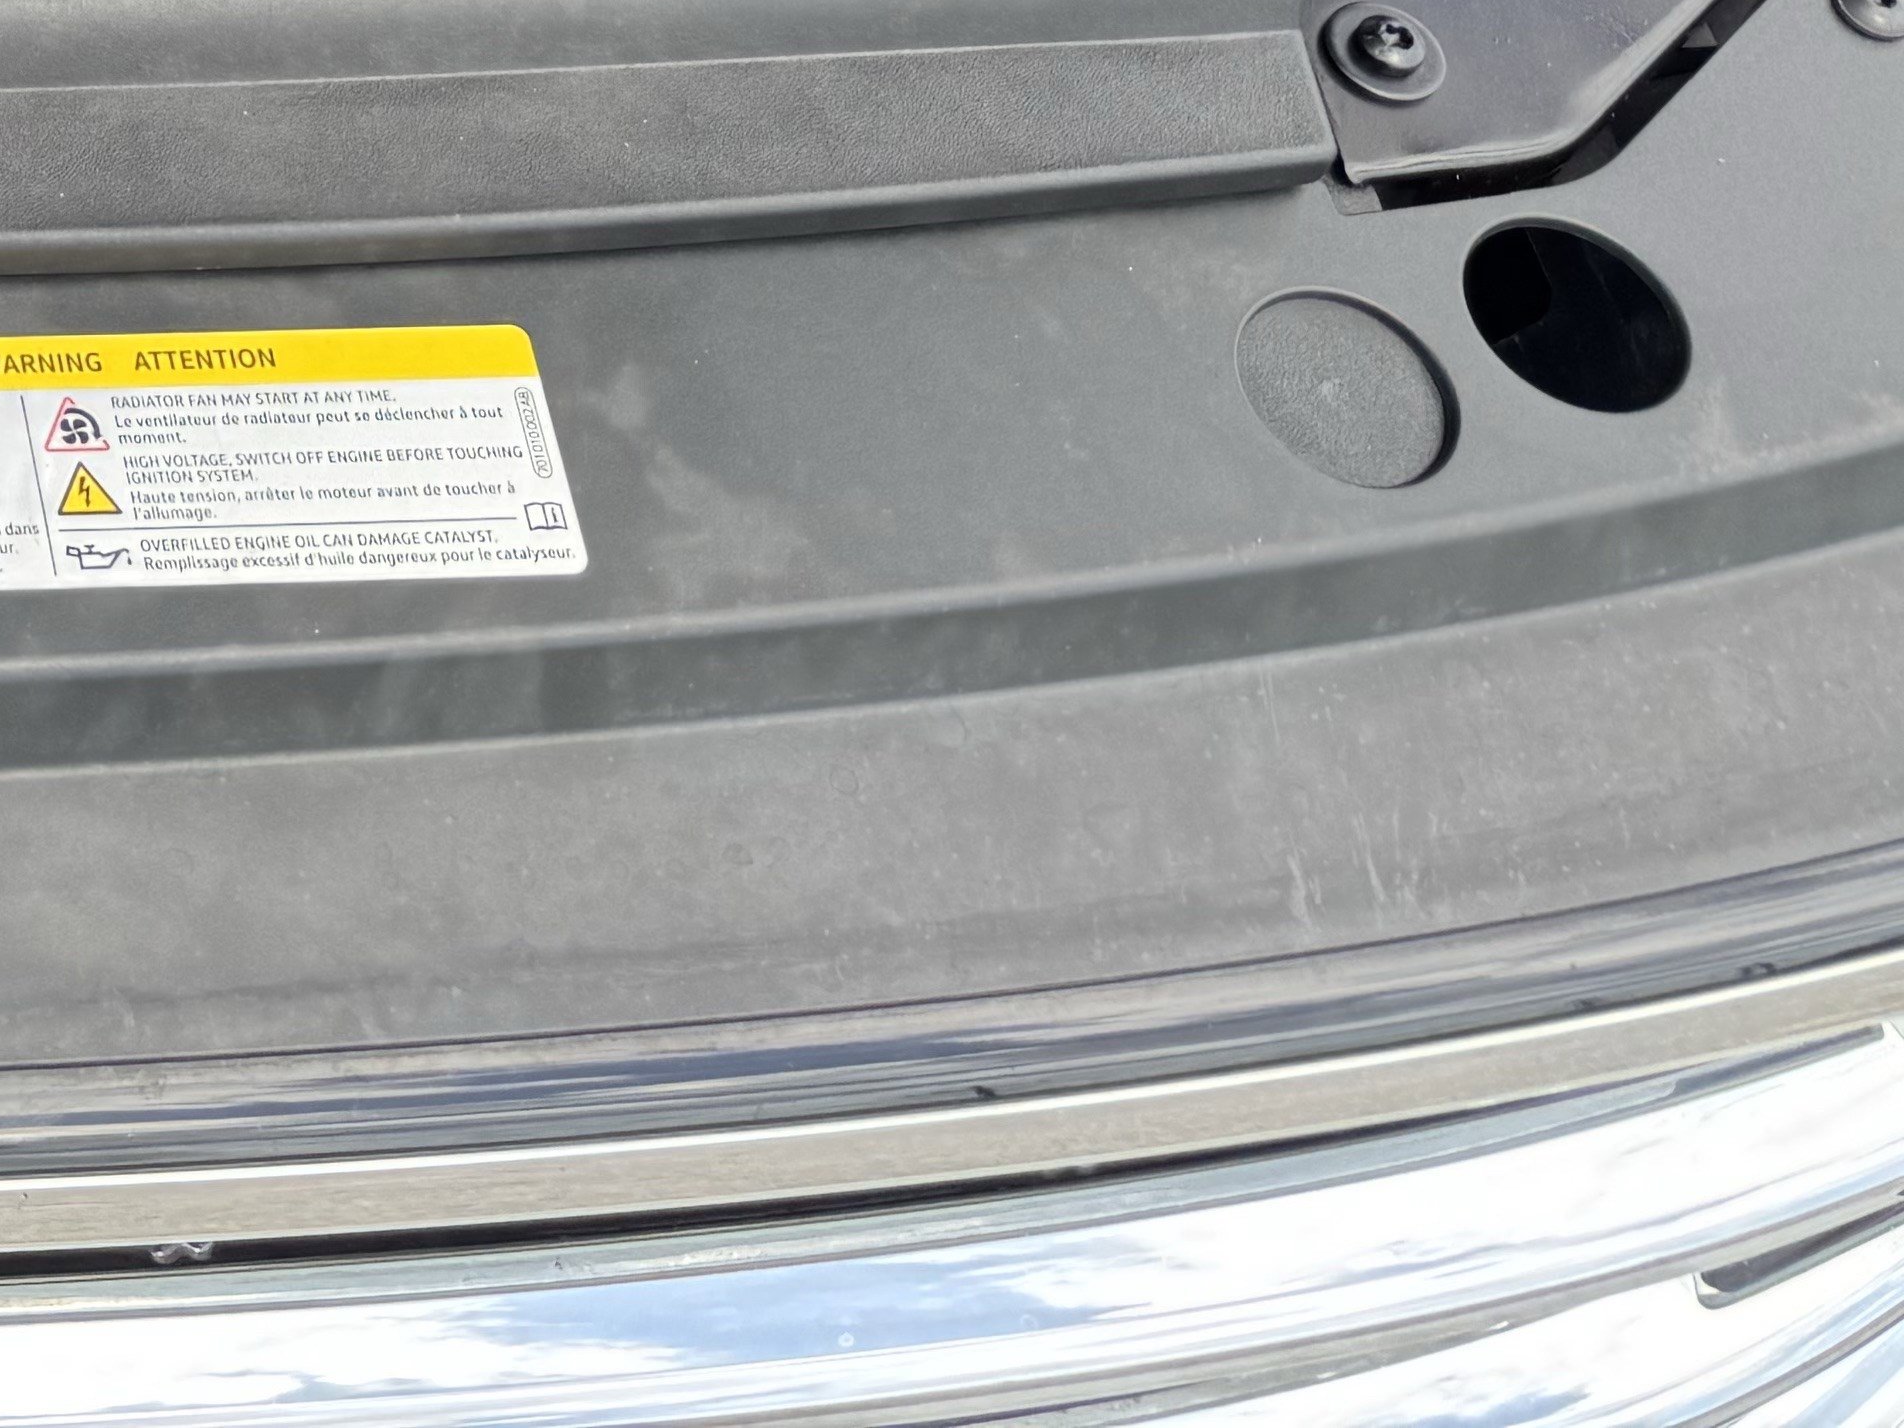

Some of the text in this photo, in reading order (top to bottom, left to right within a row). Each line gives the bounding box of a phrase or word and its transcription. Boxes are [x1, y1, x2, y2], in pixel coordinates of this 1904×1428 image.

[134, 347, 277, 372] ATTENTION
[111, 395, 185, 409] RADIATOR
[188, 394, 217, 408] FAN
[221, 393, 252, 407] MAY
[255, 391, 301, 405] START
[303, 391, 320, 404] AT
[324, 391, 356, 403] ANY
[114, 415, 132, 428] Le
[136, 413, 217, 427] ventilateur
[221, 413, 240, 425] de
[244, 411, 311, 425] radiateur
[316, 411, 350, 426] peut
[354, 412, 370, 422] se
[375, 407, 455, 422] déclencher
[471, 406, 504, 419] tout
[118, 432, 187, 445] moment.
[123, 455, 160, 469] HIGH
[235, 452, 292, 466] SWITCH
[296, 451, 323, 464] OFF
[328, 449, 383, 463] ENGINE
[387, 448, 444, 462] BEFORE
[446, 445, 523, 460] TOUCHING
[126, 470, 193, 485] IGNITION
[130, 490, 176, 504] Haute
[180, 489, 241, 504] tension,
[245, 486, 295, 502] arrêter
[300, 484, 314, 499] le
[318, 485, 372, 499] moteur
[377, 484, 418, 498] avant
[423, 483, 441, 496] de
[445, 482, 502, 496] toucher
[5, 522, 40, 536] dans
[140, 537, 230, 552] OVERFILLED
[235, 535, 290, 550] ENGINE
[295, 534, 320, 547] OIL
[323, 534, 353, 547] CAN
[358, 531, 421, 546] DAMAGE
[143, 555, 238, 573] Remplissage
[242, 553, 300, 567] excessif
[305, 551, 355, 566] d'huile
[359, 550, 437, 567] dangereux
[441, 550, 474, 563] pour
[478, 548, 492, 561] le
